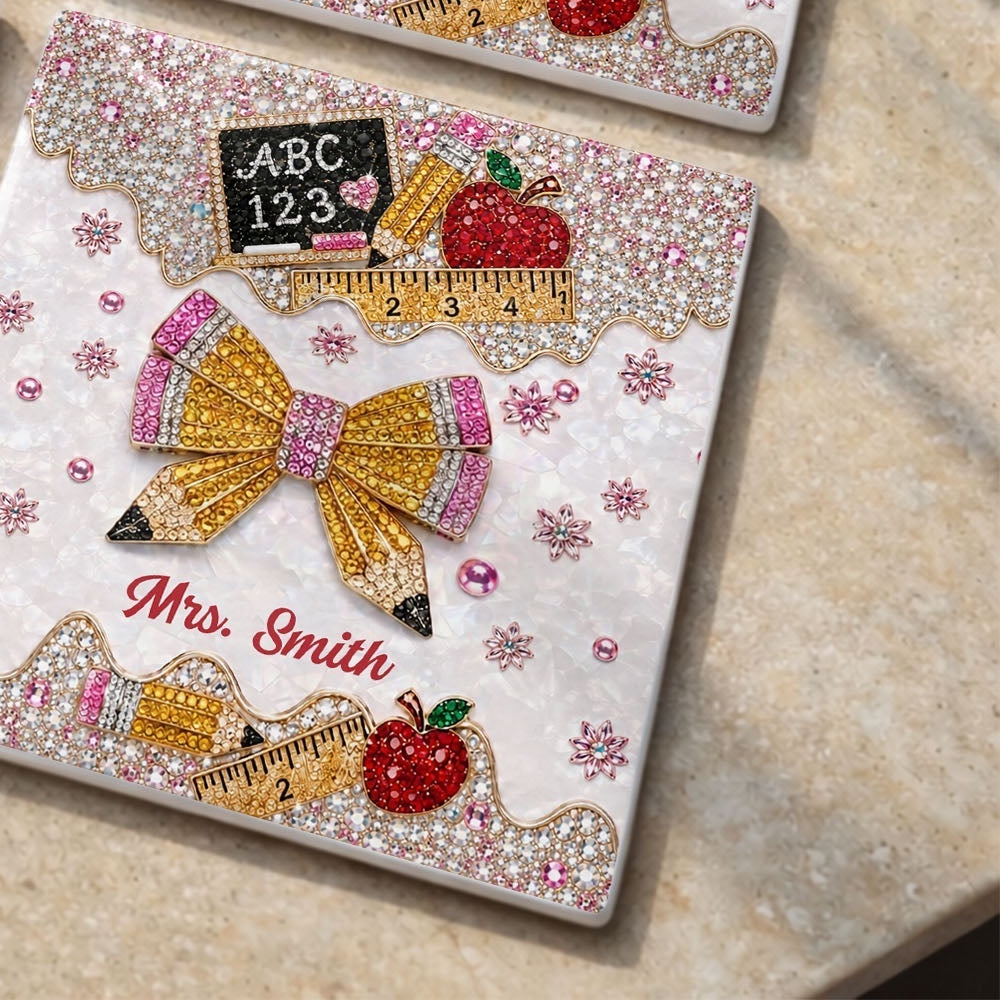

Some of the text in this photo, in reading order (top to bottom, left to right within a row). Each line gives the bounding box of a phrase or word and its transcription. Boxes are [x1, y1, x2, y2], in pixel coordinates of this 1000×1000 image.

[467, 8, 485, 28] 2
[236, 133, 344, 180] ABC
[247, 187, 336, 230] 123
[386, 296, 518, 318] 2 3 4
[122, 575, 395, 681] Mrs. Smith
[275, 778, 293, 801] 2
